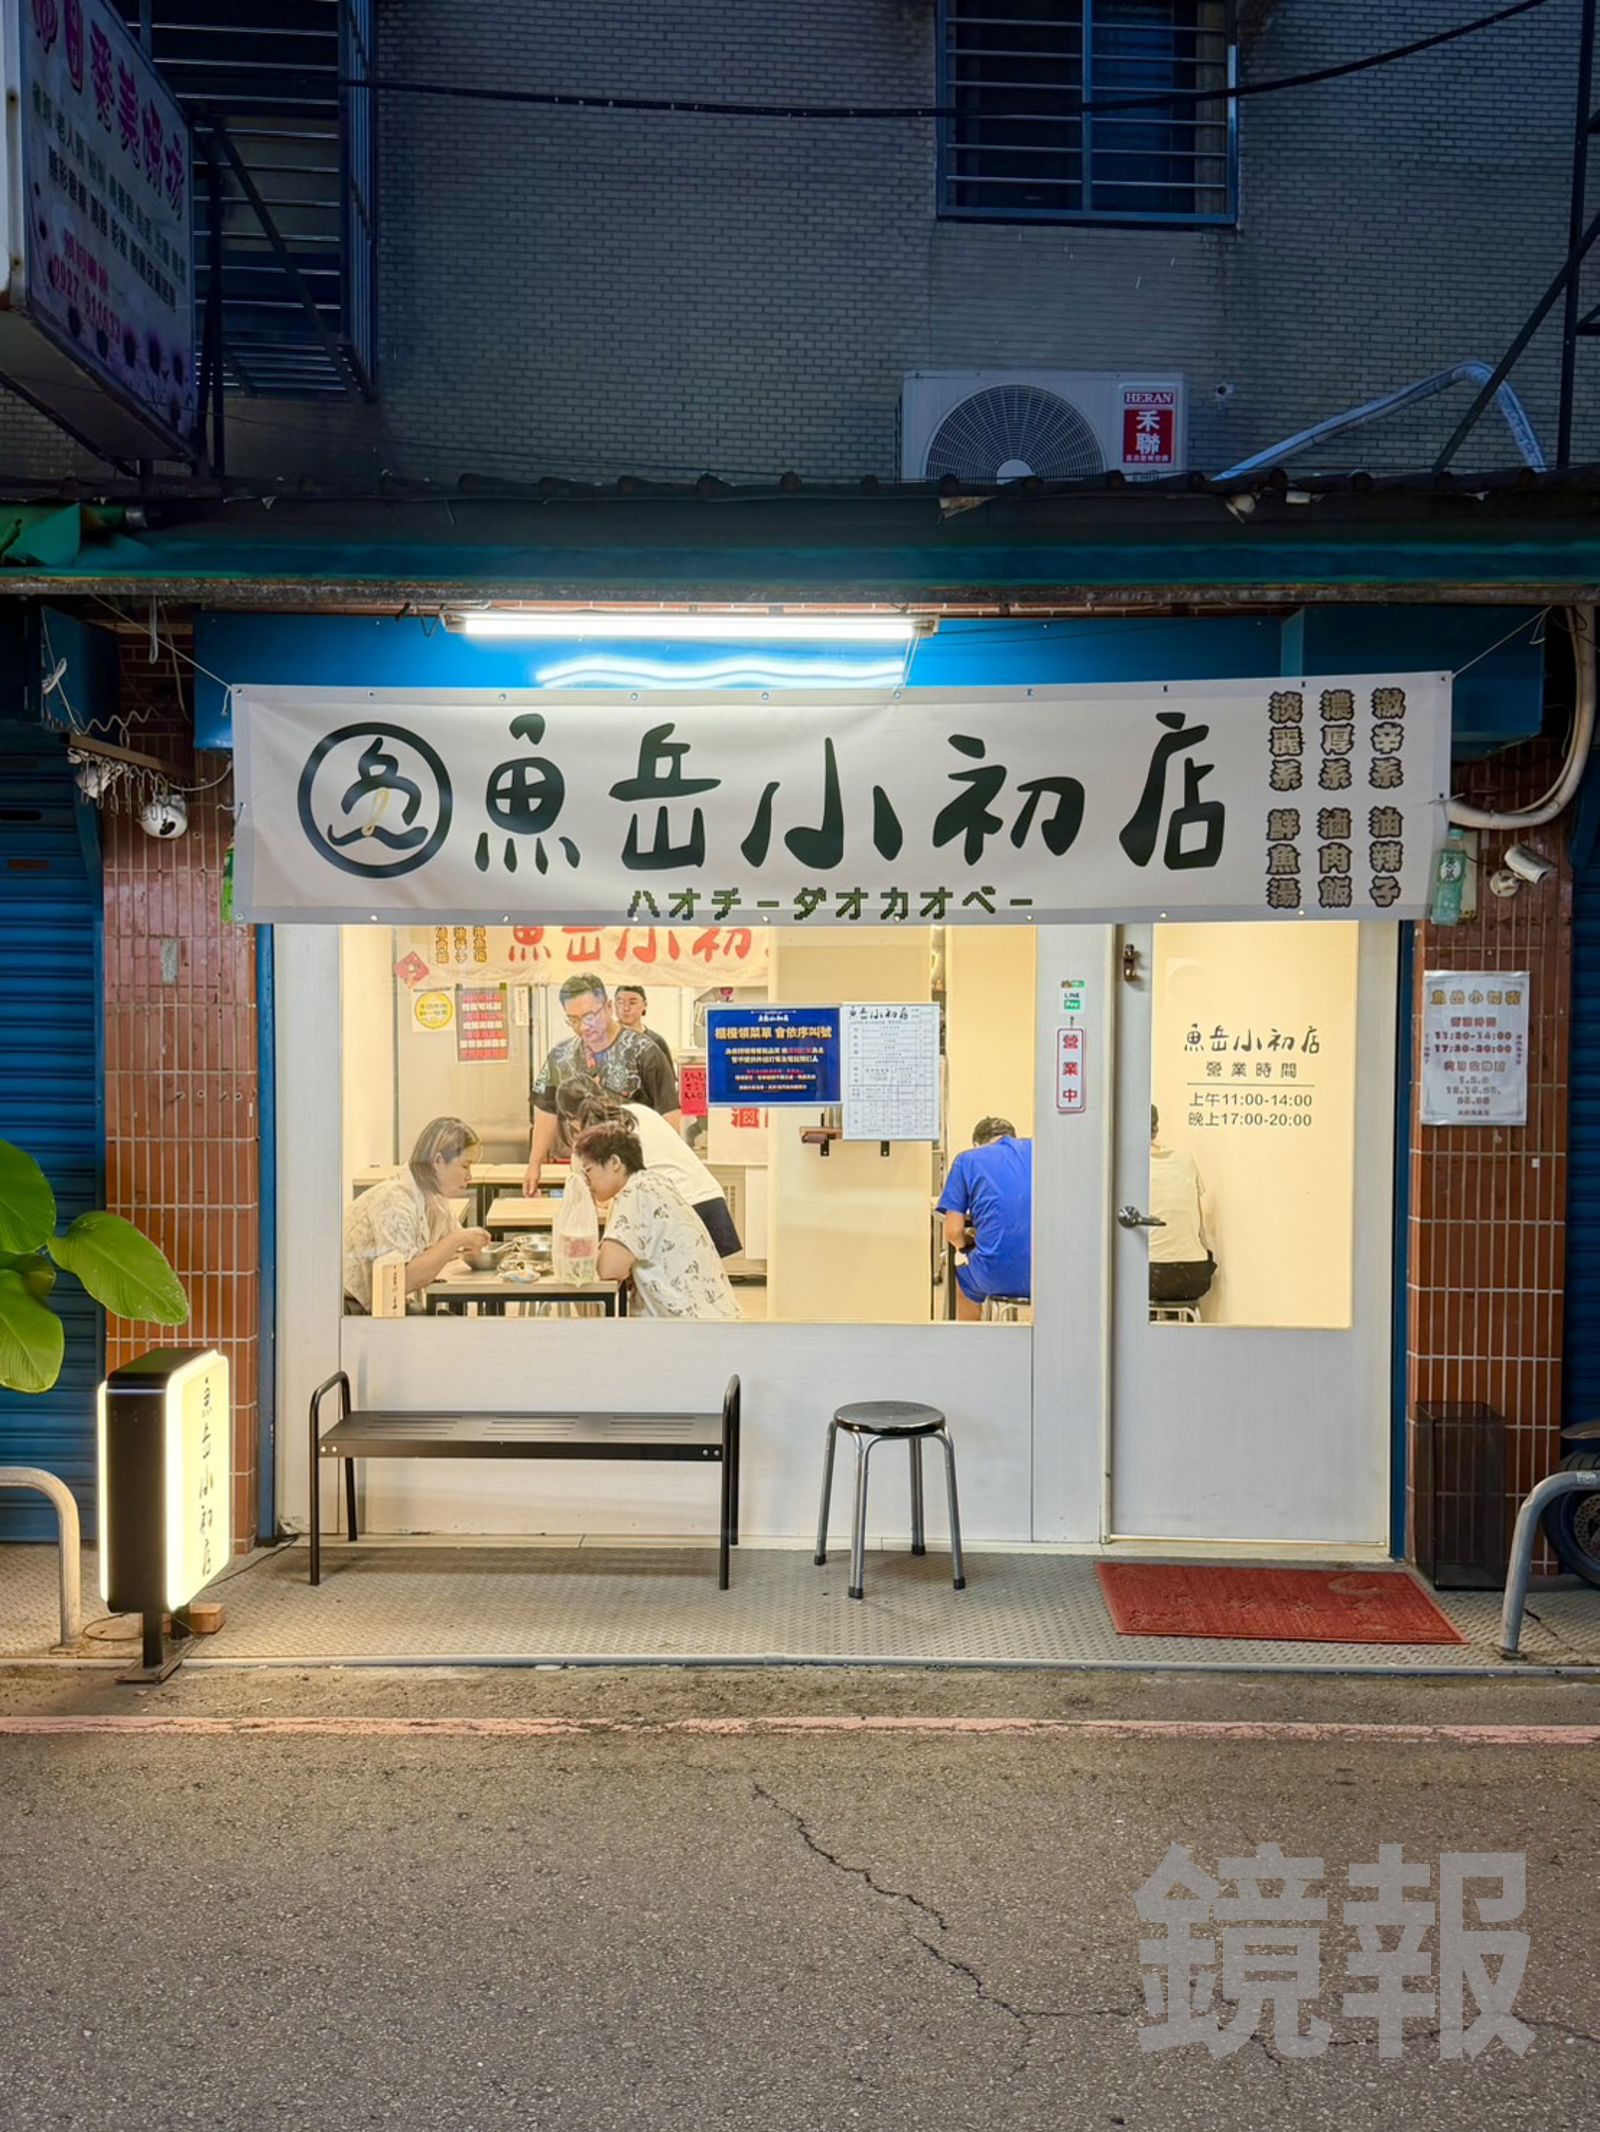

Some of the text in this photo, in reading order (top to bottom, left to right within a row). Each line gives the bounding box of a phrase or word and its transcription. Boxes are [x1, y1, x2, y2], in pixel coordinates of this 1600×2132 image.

[1126, 392, 1172, 404] HERAN
[1136, 410, 1161, 455] 禾聯
[1369, 688, 1406, 789] 激辛系
[475, 712, 1225, 875] 魚岳小初店
[1266, 690, 1305, 909] 淡麗系 鮮魚湯
[1317, 689, 1354, 909] 濃厚系 滷肉飯
[626, 886, 1033, 921] ハオチーダオカオベー
[1185, 1023, 1320, 1054] 魚岳小初店
[1062, 1034, 1079, 1103] 營業中
[1206, 1061, 1297, 1079] 營業時間
[1188, 1114, 1312, 1127] 晚上17:00-20:00
[1189, 1093, 1313, 1108] 上午11:00-14:00
